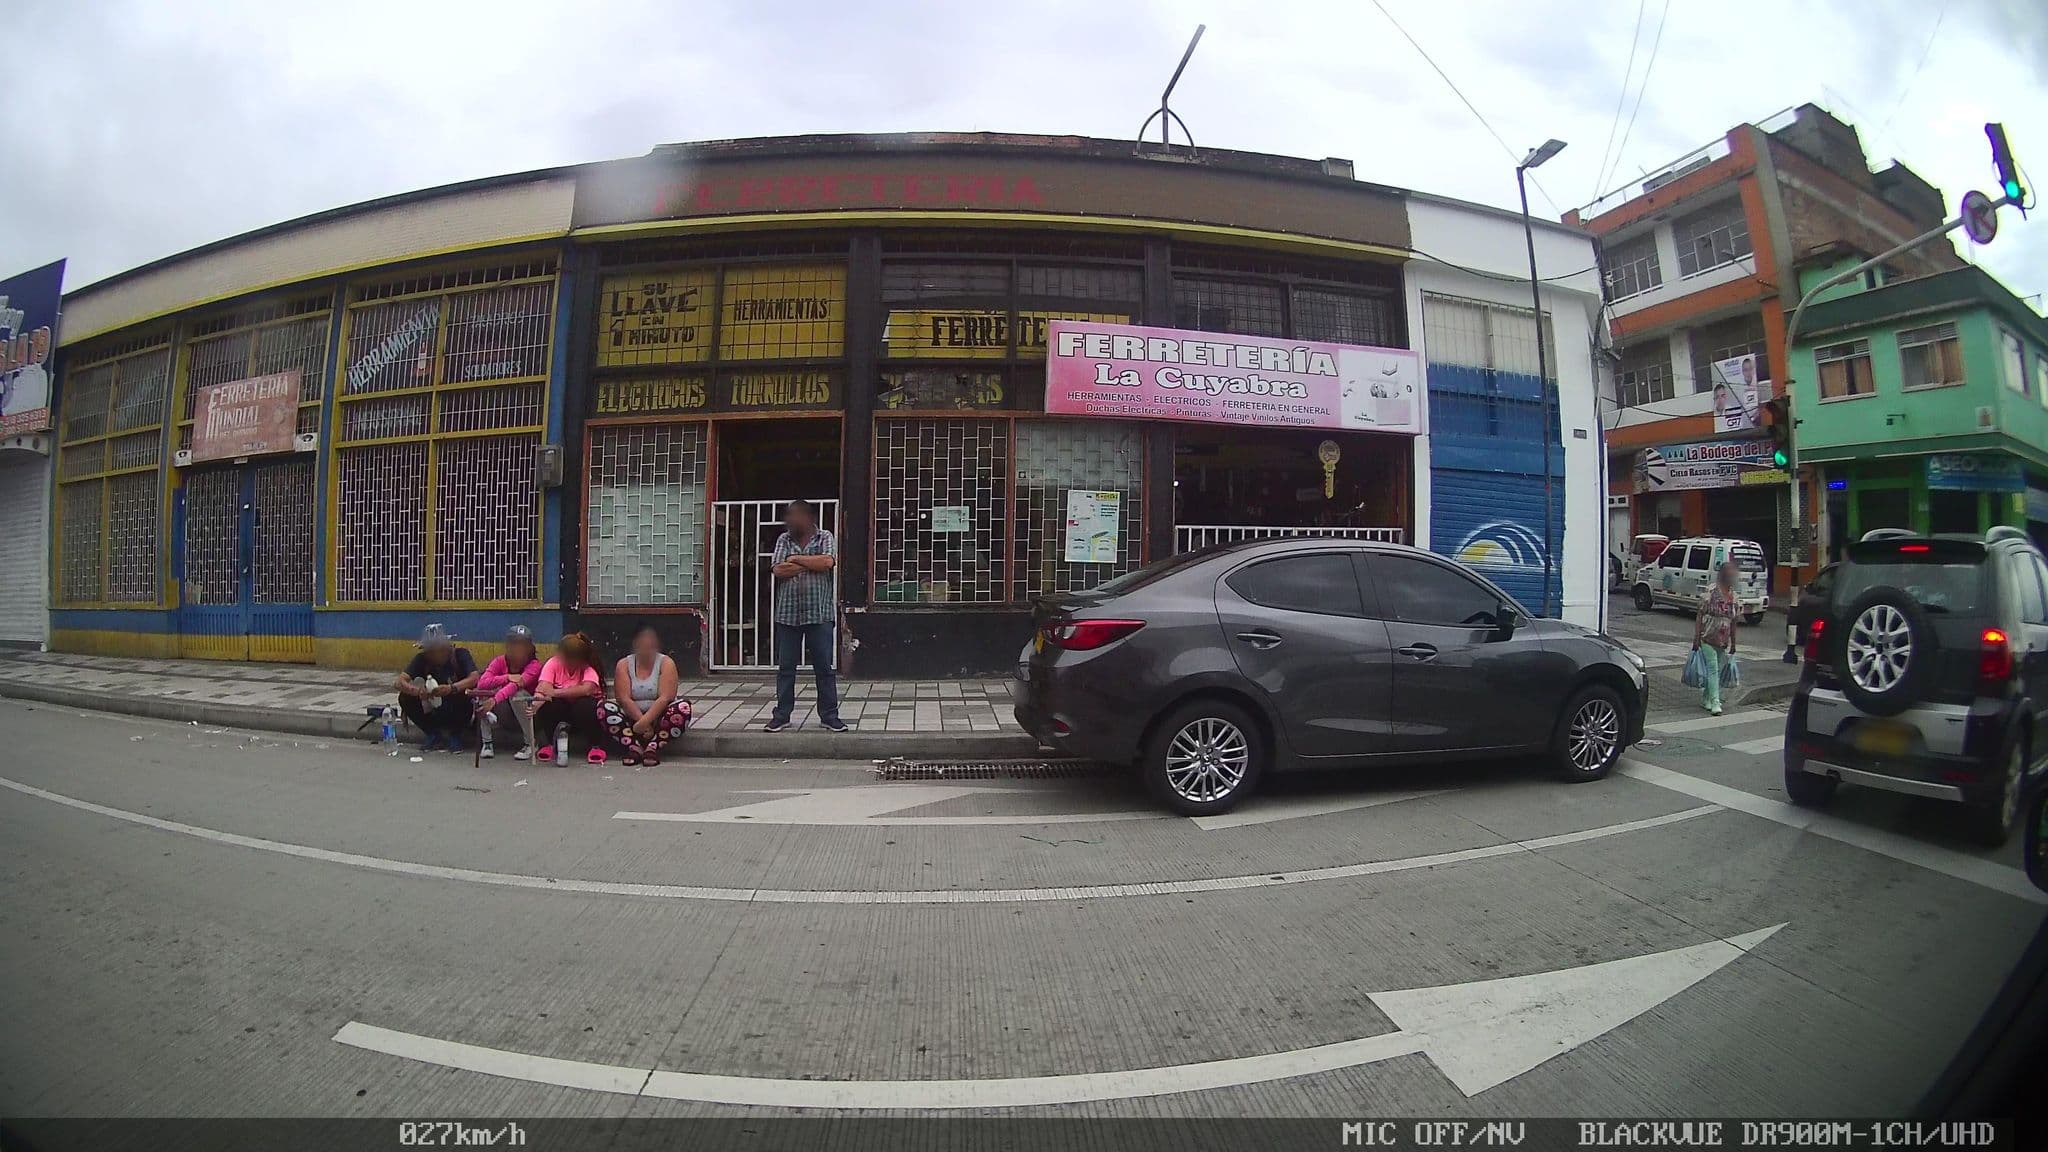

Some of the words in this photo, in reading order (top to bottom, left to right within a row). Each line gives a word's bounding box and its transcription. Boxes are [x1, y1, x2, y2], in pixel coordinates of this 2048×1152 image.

[643, 283, 667, 296] SU
[611, 288, 698, 317] LLAVE
[733, 298, 829, 321] HERRAMIENTAS
[610, 319, 624, 346] 1
[628, 326, 695, 346] MINUTO
[641, 316, 664, 326] EN
[1057, 331, 1339, 377] FERRETERÍA
[1094, 363, 1142, 388] La
[1155, 366, 1308, 398] Cuyabra
[1067, 392, 1142, 402] HERRAMIENTAS
[1154, 395, 1211, 407] ELECTRICOS
[1222, 400, 1277, 412] FERRETERIA
[1278, 404, 1290, 413] EN
[1291, 405, 1330, 416] GENERAL
[1086, 403, 1120, 413] Duchas
[1176, 408, 1212, 418] Pinturas
[1686, 447, 1698, 460] La
[1701, 444, 1742, 460] Bodega
[1744, 442, 1761, 456] del
